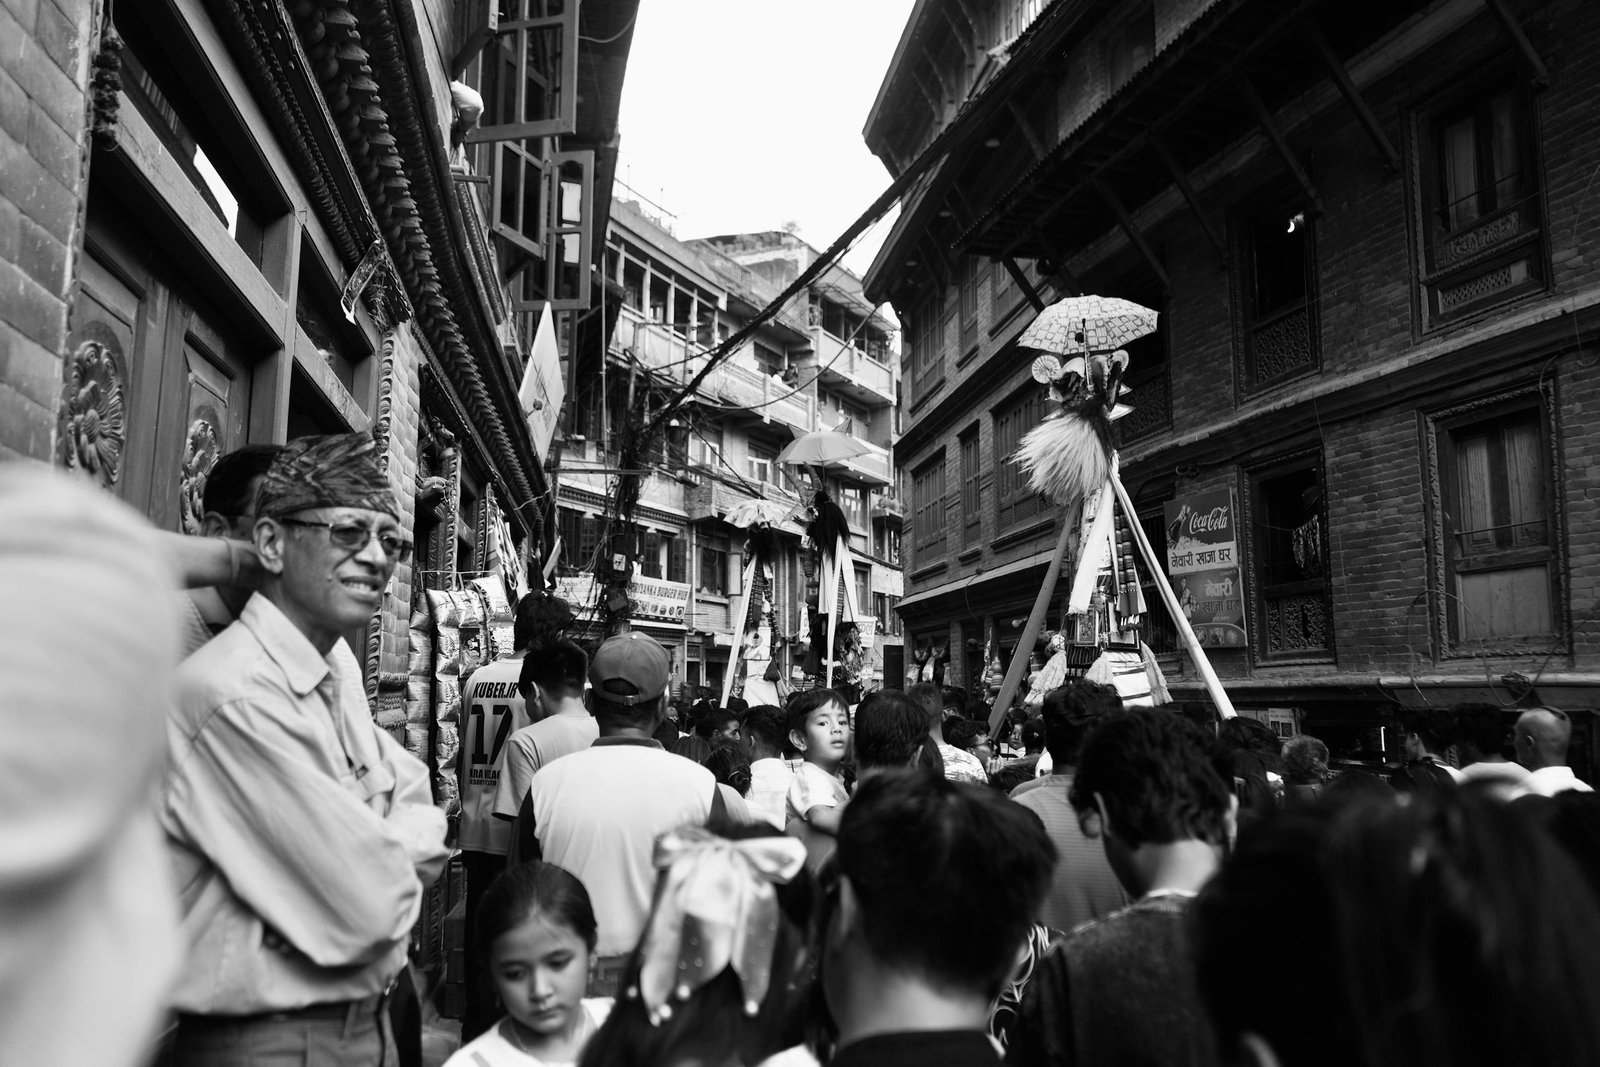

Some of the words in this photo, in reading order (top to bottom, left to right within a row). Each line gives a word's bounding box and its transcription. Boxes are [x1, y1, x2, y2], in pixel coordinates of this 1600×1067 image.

[1190, 506, 1229, 534] Coca-Cola
[1171, 551, 1194, 567] नेवारी
[1195, 550, 1216, 565] खाजा
[1218, 547, 1231, 561] घर
[657, 586, 678, 599] BURGER
[1204, 578, 1233, 597] नेवारी
[470, 704, 514, 766] 17
